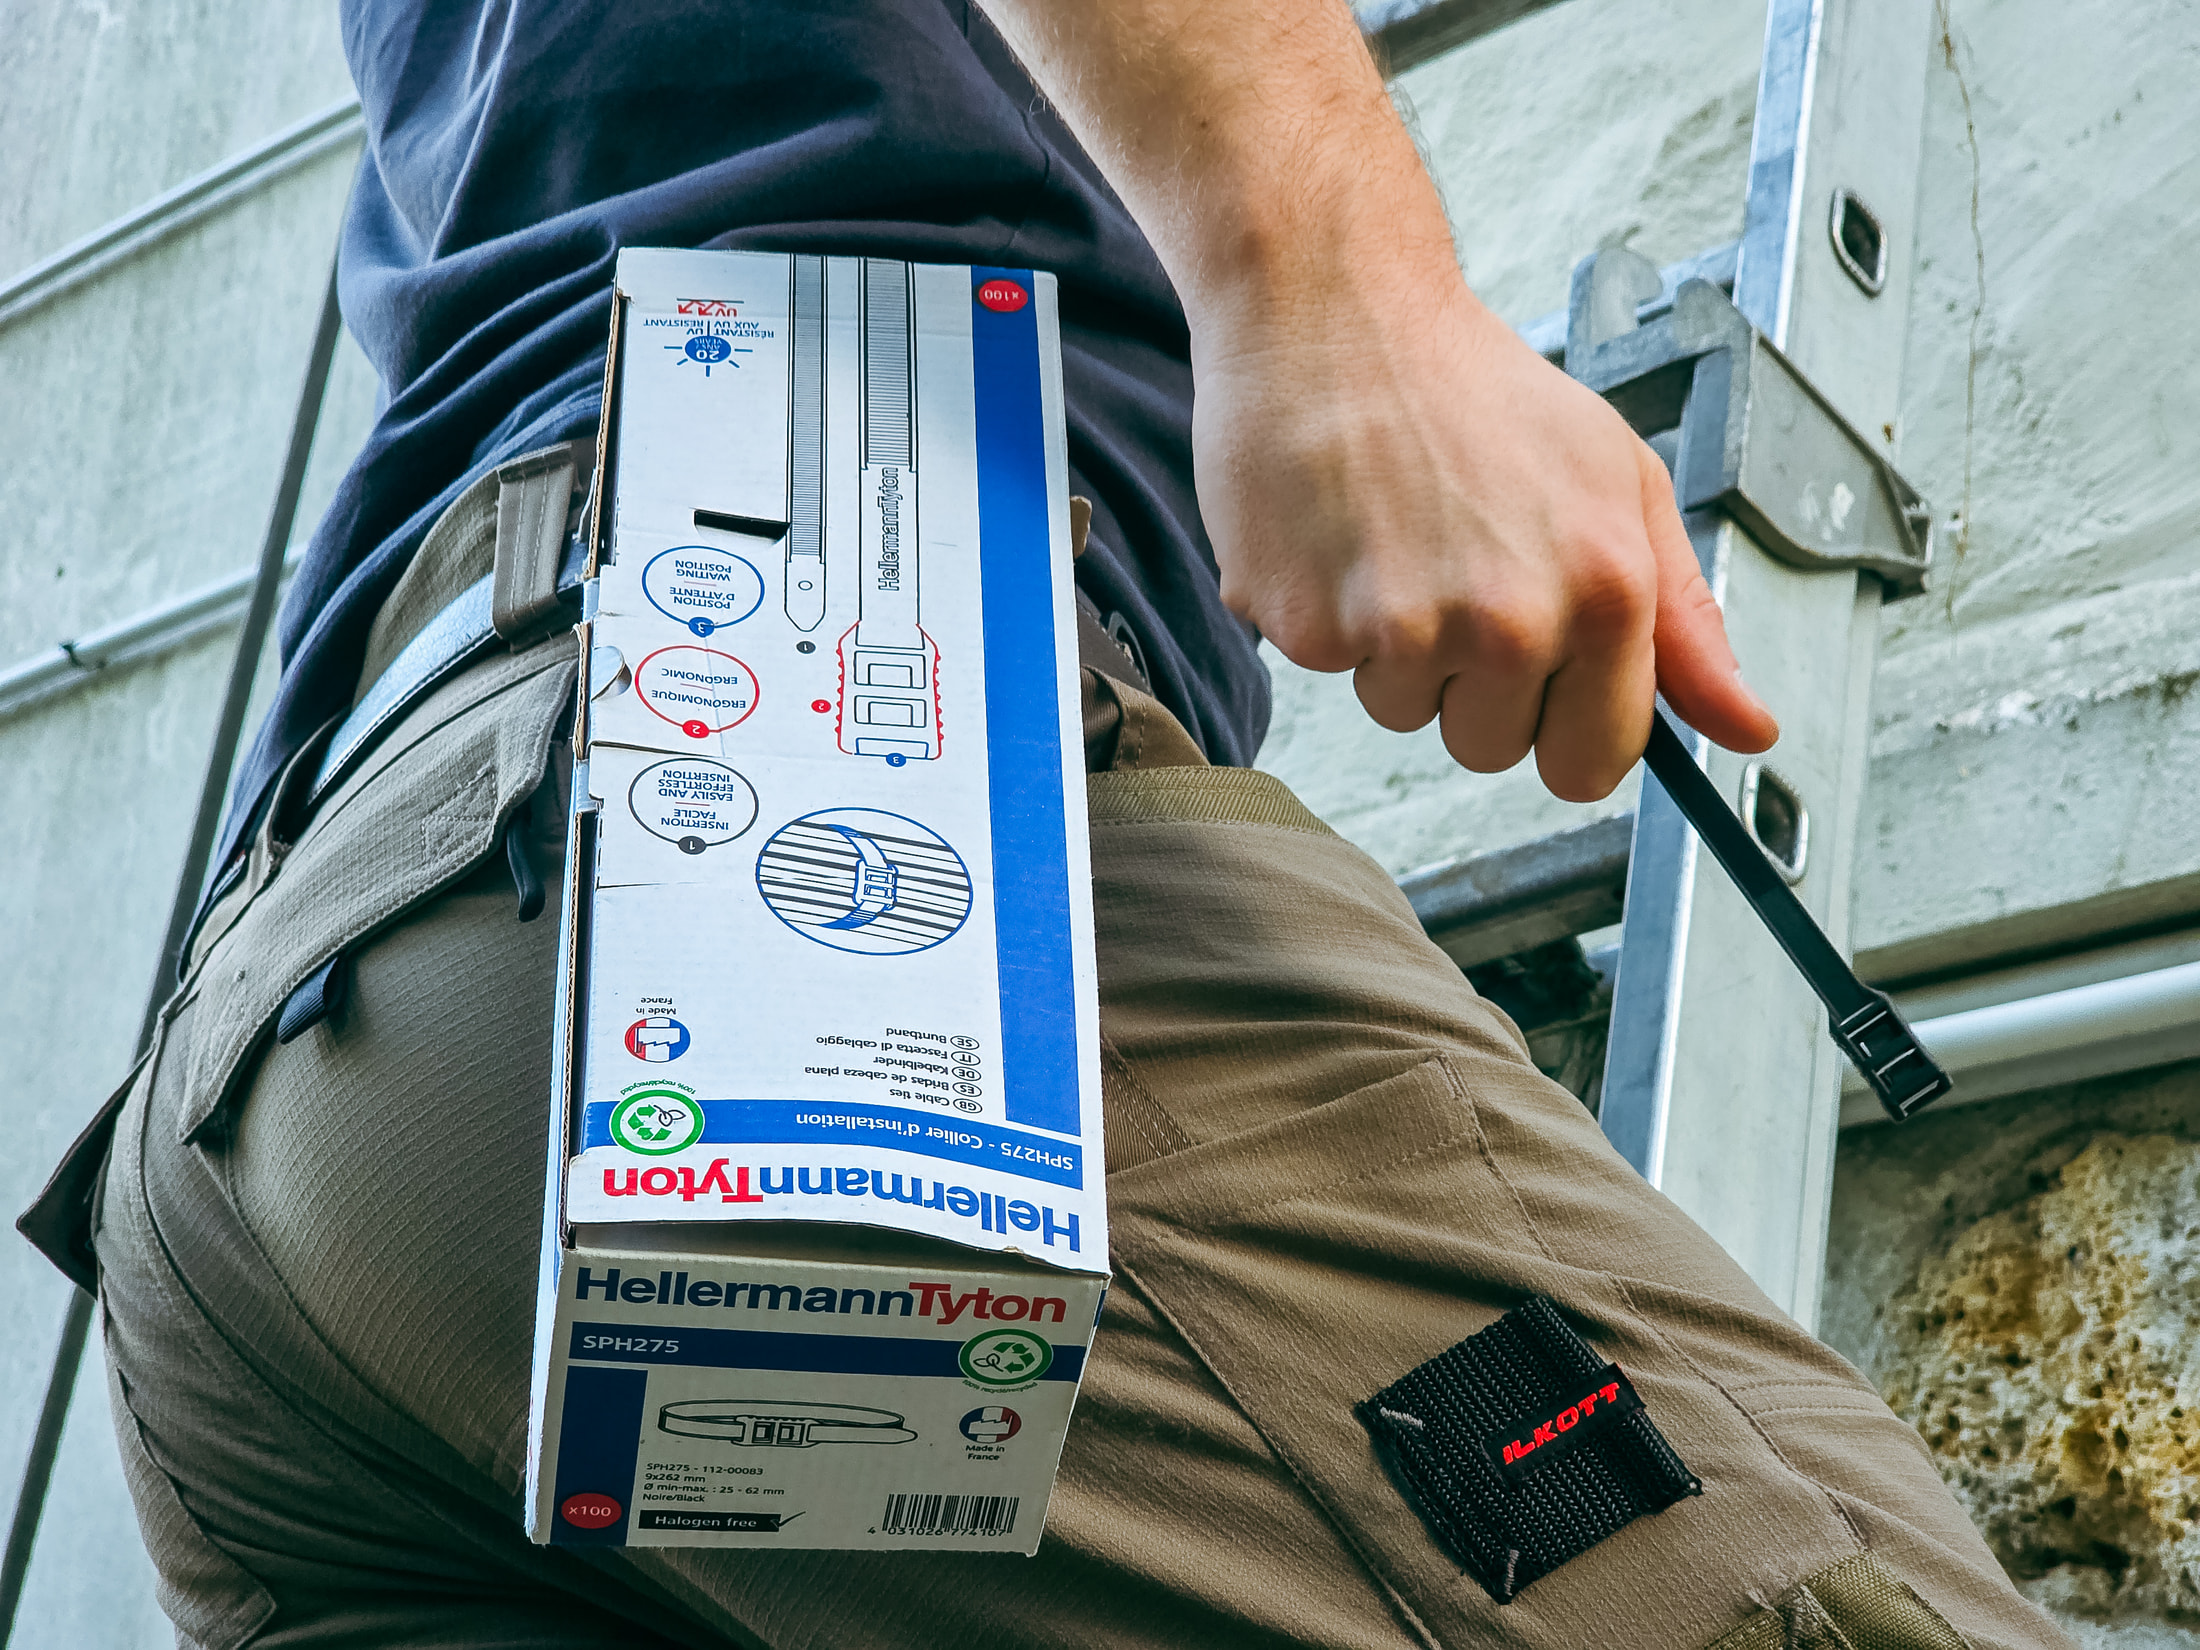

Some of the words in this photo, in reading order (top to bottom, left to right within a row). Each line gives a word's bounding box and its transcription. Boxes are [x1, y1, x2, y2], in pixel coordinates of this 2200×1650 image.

[715, 308, 737, 317] UV
[714, 321, 730, 329] UV
[735, 321, 759, 330] AUX
[696, 350, 720, 361] 20
[877, 467, 902, 592] HellermannTyton
[675, 560, 732, 574] POSITION
[676, 569, 731, 582] WAITING
[669, 586, 735, 601] D'ATTENTE
[673, 596, 731, 609] POSITION
[661, 668, 738, 685] ERGONOMIC
[651, 689, 746, 709] ERGONOMIQUE
[692, 725, 701, 734] 2
[662, 769, 730, 783] INSERTION
[658, 778, 734, 792] EFFORTLESS
[659, 788, 688, 799] AND
[691, 790, 733, 801] EASILY
[674, 809, 716, 820] FACILE
[661, 817, 729, 830] INSERTION
[640, 997, 673, 1005] France
[636, 1007, 645, 1015] in
[648, 1007, 677, 1015] Made
[886, 1027, 947, 1044] Buntband
[816, 1036, 877, 1049] cablaggio
[881, 1042, 892, 1051] di
[957, 1037, 973, 1047] SE
[896, 1044, 948, 1059] Fascetta
[959, 1053, 972, 1063] IT
[873, 1056, 948, 1075] Kabelbinder
[804, 1066, 839, 1077] plana
[843, 1069, 888, 1080] cabeza
[958, 1069, 975, 1079] DE
[891, 1073, 907, 1084] de
[911, 1076, 949, 1090] Bridas
[677, 1083, 696, 1094] 100%
[889, 1088, 911, 1100] ties
[959, 1084, 975, 1095] ES
[915, 1092, 950, 1107] Cable
[959, 1101, 977, 1111] GB
[796, 1112, 921, 1137] d'installation
[925, 1123, 984, 1149] Collier
[1000, 1142, 1074, 1171] SPH275
[603, 1157, 1080, 1253] HellermannTyton
[575, 1266, 1067, 1325] HellermannTyton
[583, 1335, 680, 1353] SPH275
[1502, 1381, 1620, 1465] ILKOTT
[967, 1453, 1000, 1461] France
[646, 1462, 690, 1472] SPH275
[703, 1465, 764, 1475] 112-00083
[645, 1473, 680, 1482] 9x262
[719, 1486, 734, 1494] 25
[745, 1486, 759, 1495] 62
[642, 1493, 705, 1503] Noire/Black
[655, 1515, 721, 1527] Halogen
[726, 1516, 757, 1527] free
[867, 1527, 876, 1535] 4
[887, 1527, 943, 1536] 031026
[951, 1528, 1007, 1537] 774107
